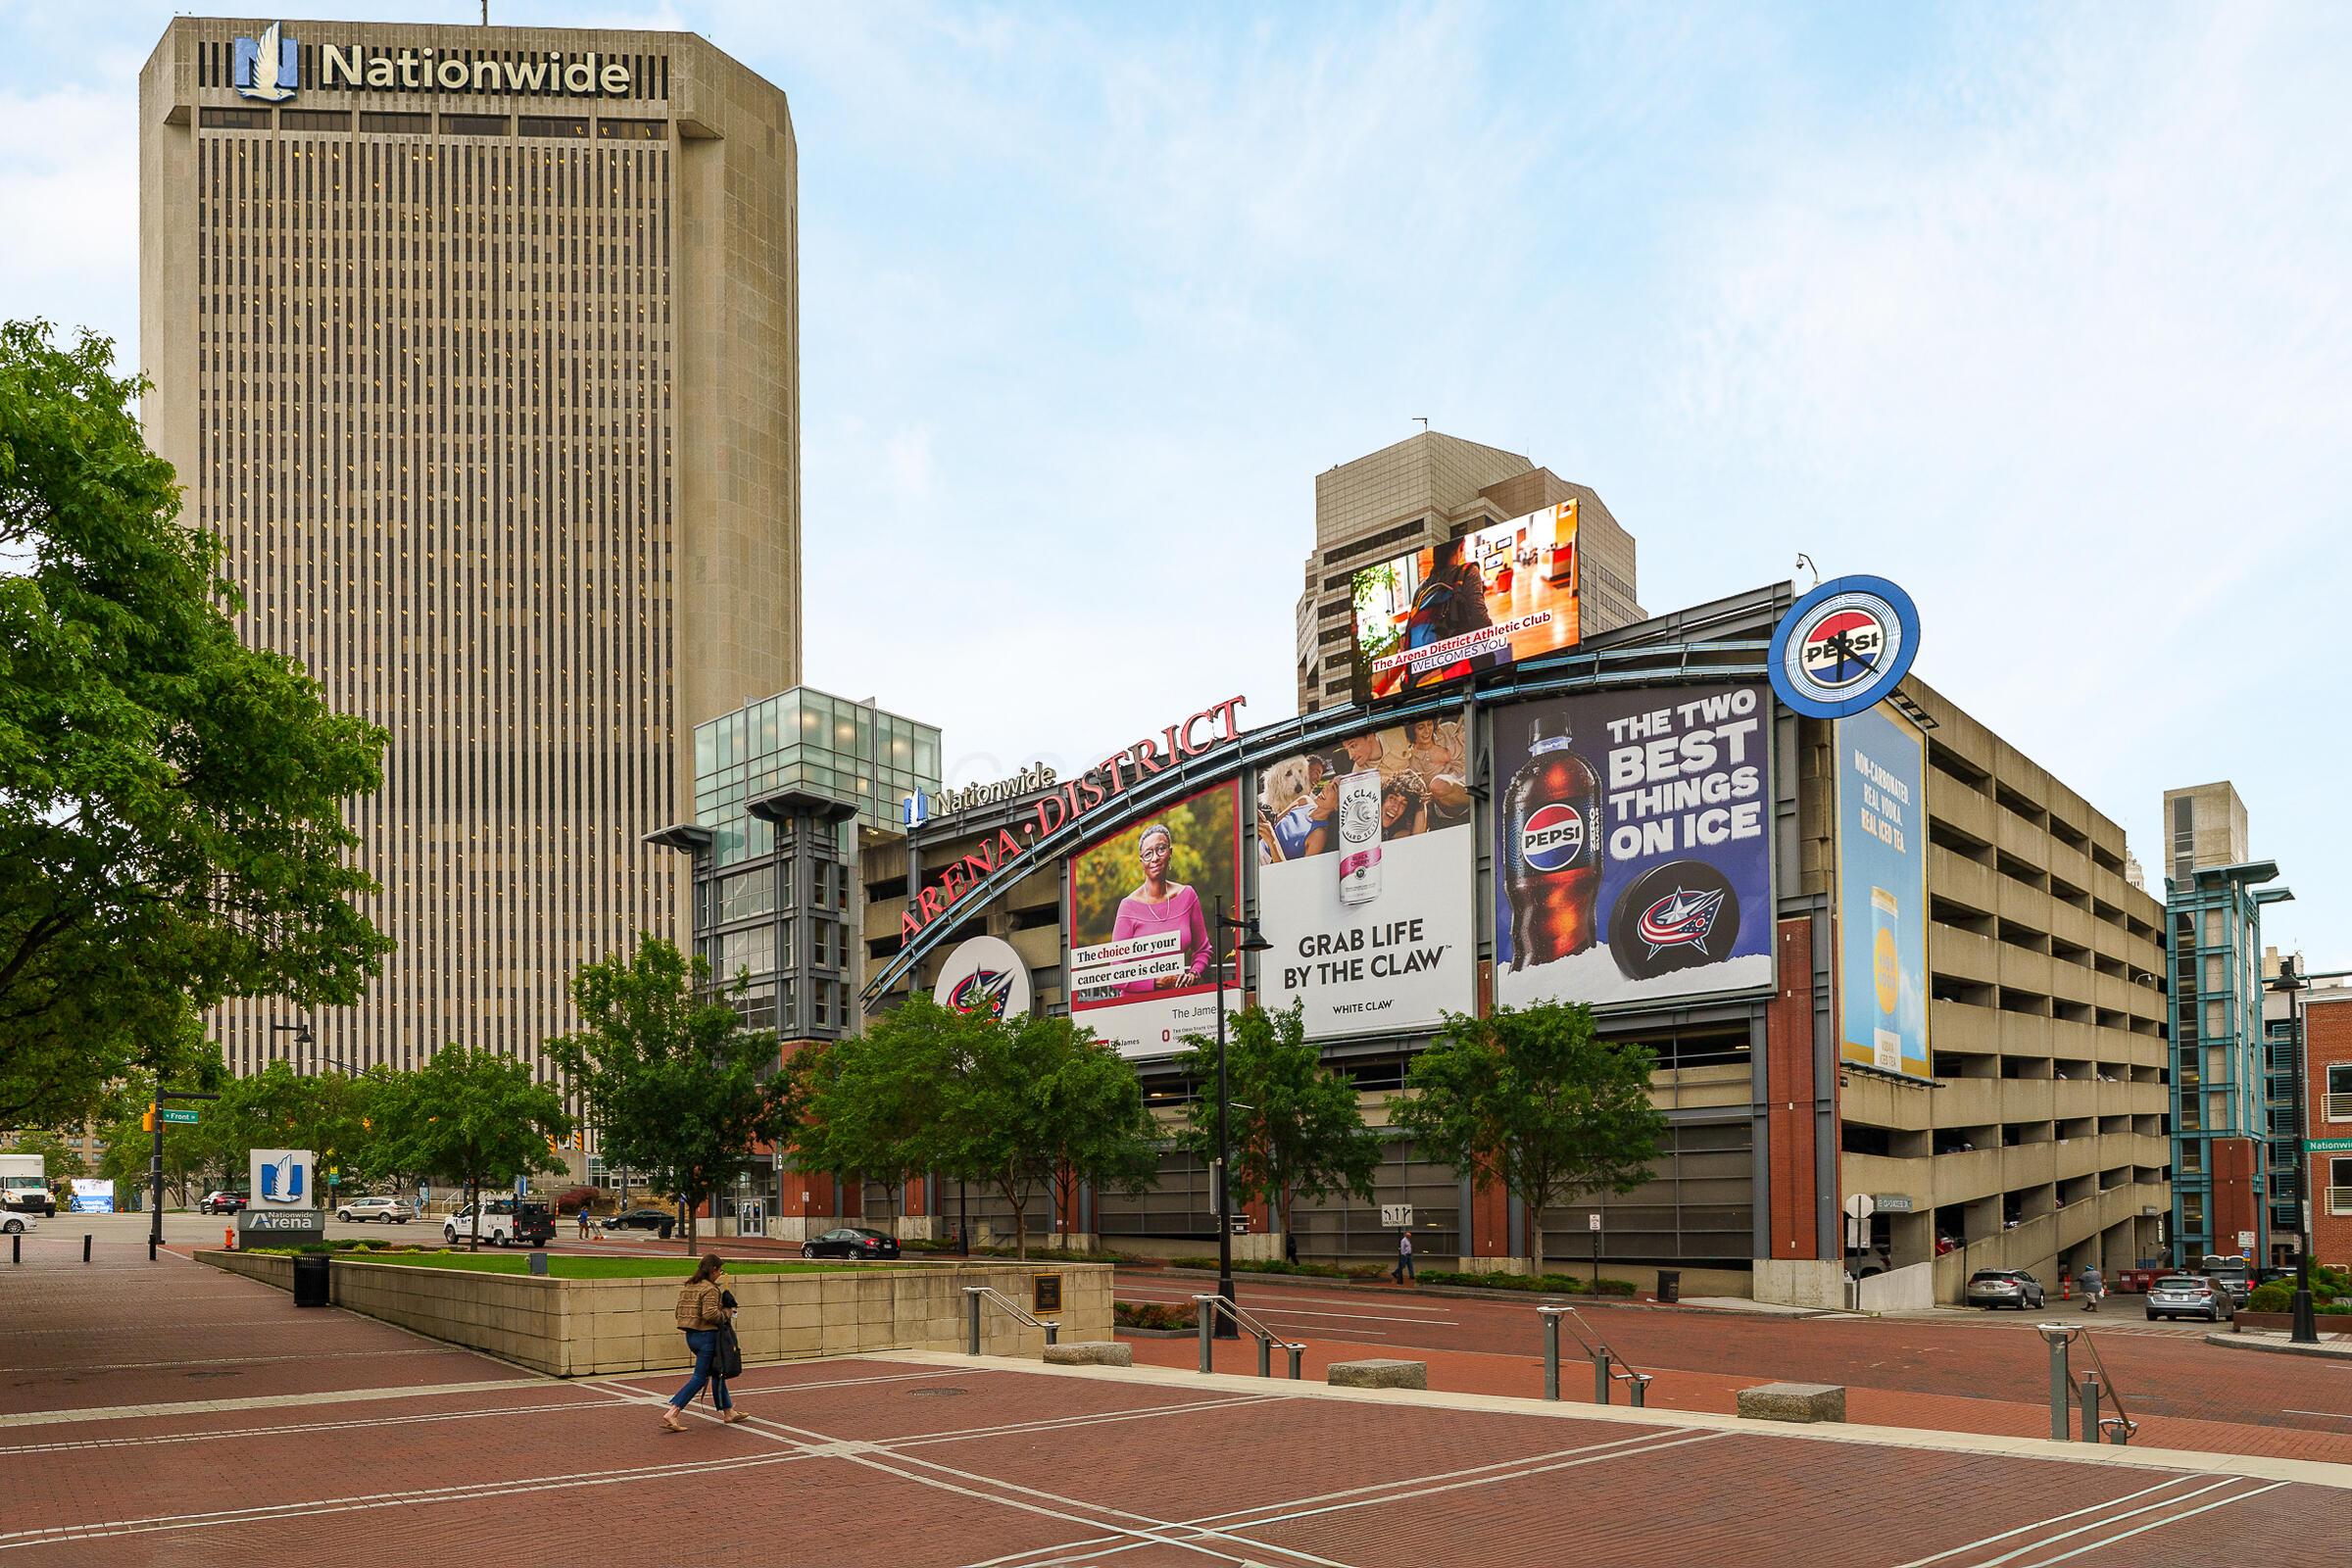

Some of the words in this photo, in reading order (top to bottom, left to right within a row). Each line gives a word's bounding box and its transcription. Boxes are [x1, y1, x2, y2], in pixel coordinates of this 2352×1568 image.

[321, 43, 630, 95] Nationwide
[1374, 660, 1394, 671] The
[1396, 650, 1427, 665] Arena
[1429, 636, 1471, 655] District
[1473, 622, 1520, 643] Athletic
[1522, 612, 1551, 628] Club
[1412, 645, 1478, 672] WELCOMES
[1482, 638, 1507, 653] YOU
[1606, 708, 1672, 744] THE
[1677, 688, 1757, 728] TWO
[1608, 717, 1758, 791] BEST
[935, 760, 1057, 816] Nationwide
[1608, 765, 1760, 821] THINGS
[1854, 749, 1911, 808] NON-CARBONATED.
[899, 828, 1026, 948] ARENA
[1034, 694, 1247, 840] DISTRICT
[1340, 794, 1353, 828] WHITE
[1353, 788, 1379, 804] CLAW
[1864, 783, 1880, 811] REAL
[1881, 794, 1903, 827] VODKA.
[1525, 825, 1580, 849] PEPSI
[1609, 817, 1674, 862] ON
[1684, 801, 1761, 849] ICE
[1861, 807, 1878, 837] REAL
[1878, 818, 1892, 845] ICED
[1893, 827, 1906, 856] TEA.
[1077, 951, 1097, 963] The
[1097, 945, 1130, 959] choice
[1132, 941, 1150, 954] for
[1150, 937, 1177, 954] your
[1298, 928, 1364, 958] GRAB
[1372, 917, 1424, 949] LIFE
[1077, 972, 1112, 986] cancer
[1113, 967, 1137, 980] care
[1138, 963, 1148, 976] is
[1150, 960, 1180, 974] clear.
[1284, 964, 1312, 990] BY
[1316, 957, 1364, 986] THE
[1172, 1008, 1190, 1019] The
[1192, 1005, 1218, 1017] Jame
[1333, 1003, 1364, 1014] WHITE
[2310, 1141, 2352, 1150] Nationwi
[248, 1212, 313, 1229] Arena
